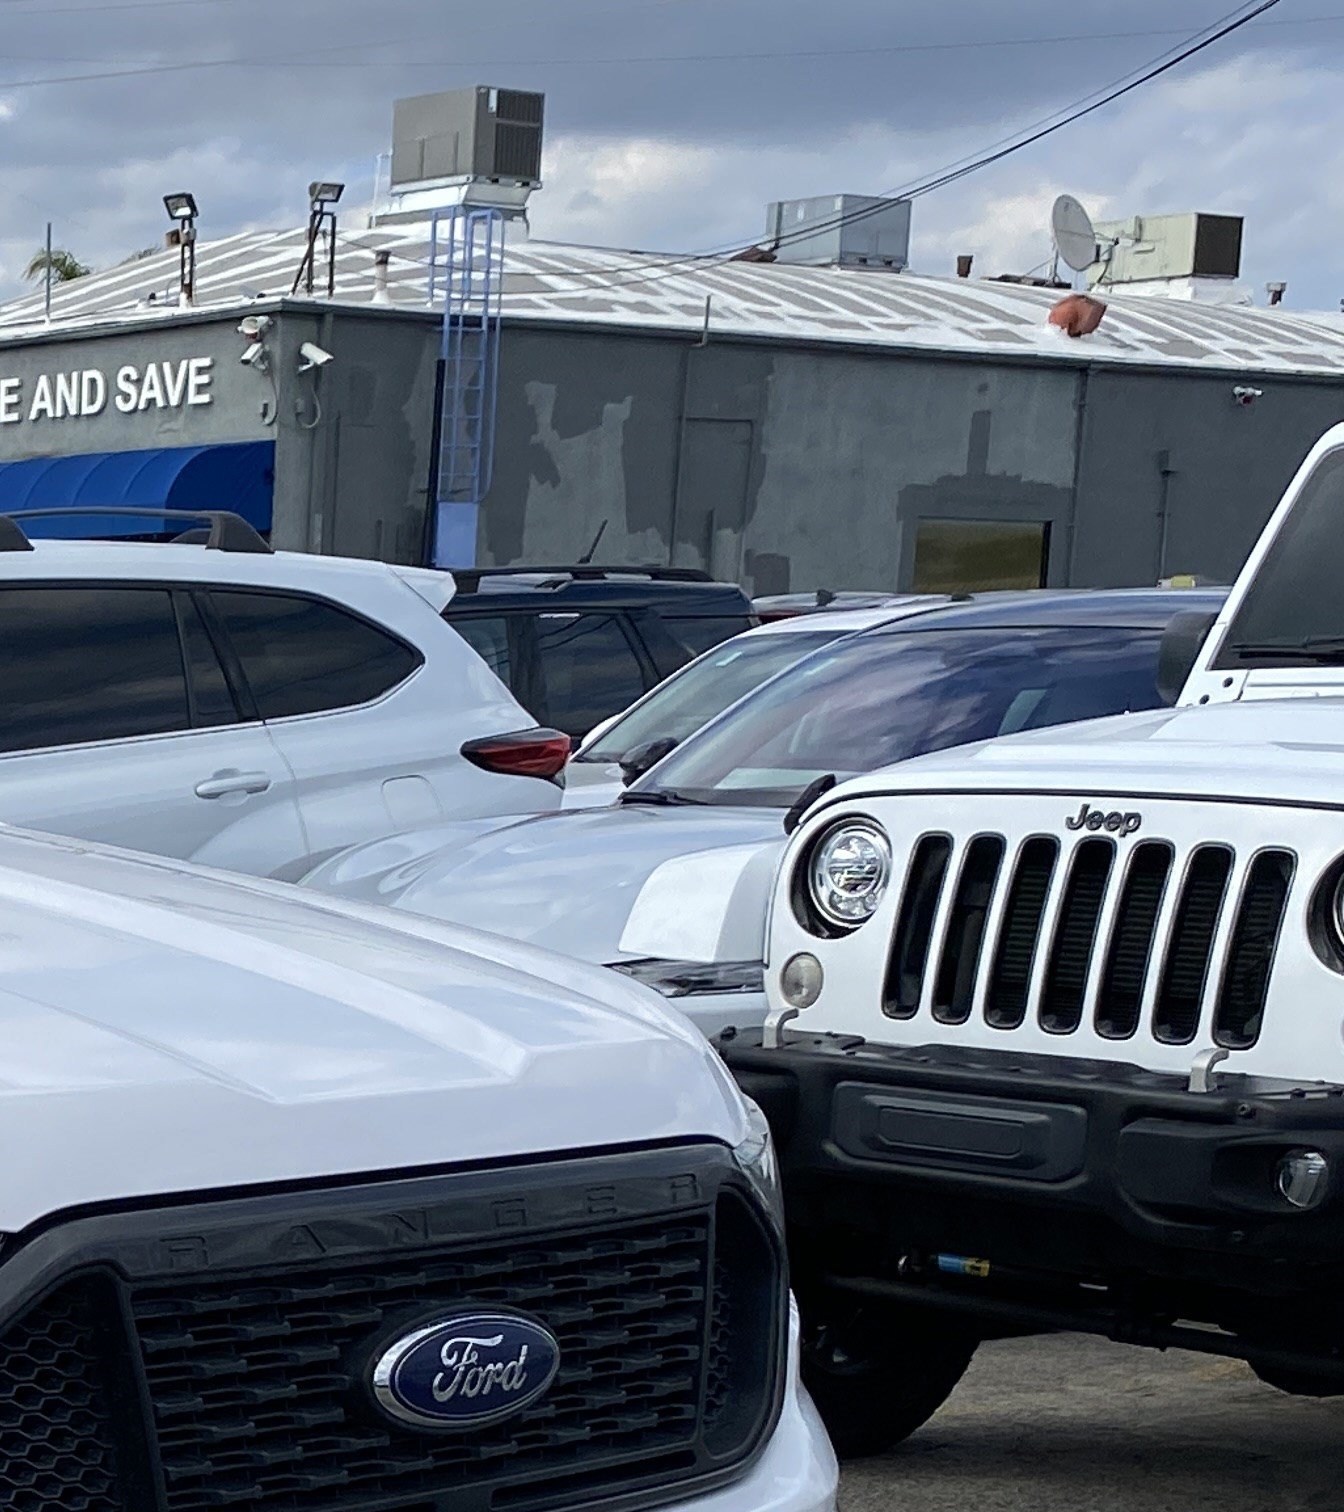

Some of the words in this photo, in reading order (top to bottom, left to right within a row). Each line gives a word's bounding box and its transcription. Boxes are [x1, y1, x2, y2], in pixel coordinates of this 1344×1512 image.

[29, 369, 106, 420] AND
[115, 357, 212, 413] SAVE
[1065, 804, 1142, 837] Jeep
[159, 1173, 699, 1270] RANGER
[432, 1334, 529, 1403] Ford
